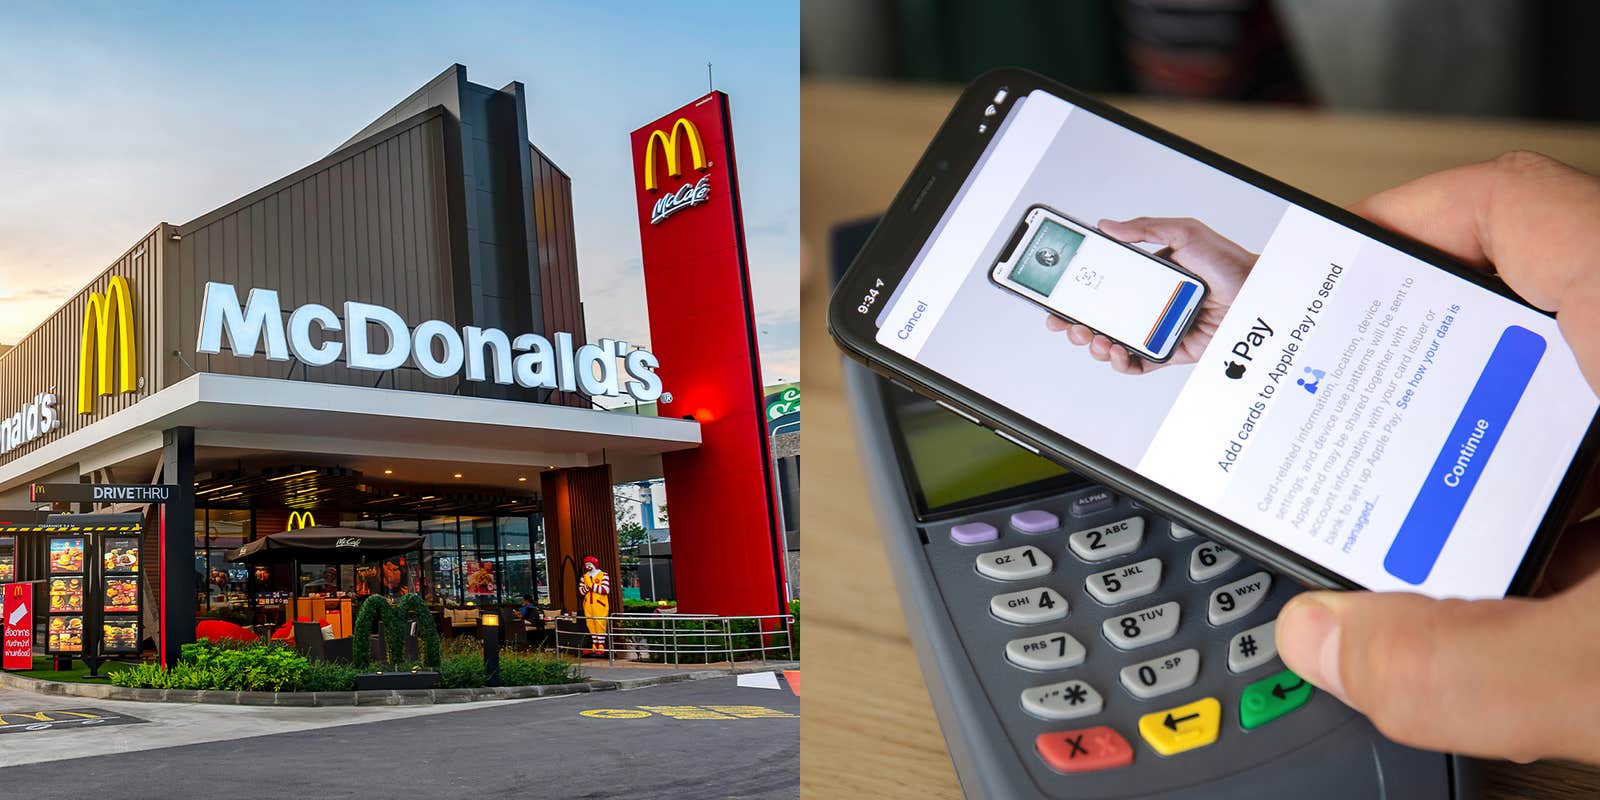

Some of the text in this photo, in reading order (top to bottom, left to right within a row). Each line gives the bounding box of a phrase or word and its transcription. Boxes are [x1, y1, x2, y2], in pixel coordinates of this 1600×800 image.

[651, 174, 711, 224] McCafé
[857, 286, 879, 315] 9:34
[897, 300, 929, 341] Cancel
[196, 281, 662, 402] McDonald's
[1232, 316, 1275, 361] Pay
[1217, 262, 1342, 472] Add cards to Apple Pay to send
[1257, 299, 1382, 511] Card-related information, location, device
[1275, 277, 1414, 519] settings, and device use patterns will be sent to
[0, 392, 57, 453] nald's
[1291, 325, 1408, 528] Apple and may be shared together with
[1309, 308, 1435, 536] account information with your card issuer or
[1324, 303, 1461, 544] bank to set up Apple Pay. See how your data is
[1444, 419, 1489, 488] Continue
[93, 486, 170, 501] DRIVETHRU
[1079, 493, 1108, 504] ALPHA
[1086, 522, 1128, 550] 2 ABC
[1022, 549, 1037, 567] 1
[1198, 548, 1217, 567] 6
[1102, 565, 1143, 592] 5 JKL
[1008, 591, 1055, 609] GHI 4
[1216, 582, 1261, 611] 9 WXY
[1120, 608, 1164, 638] 8 TUV
[1023, 636, 1066, 657] PRS 7
[1138, 665, 1157, 686] 0
